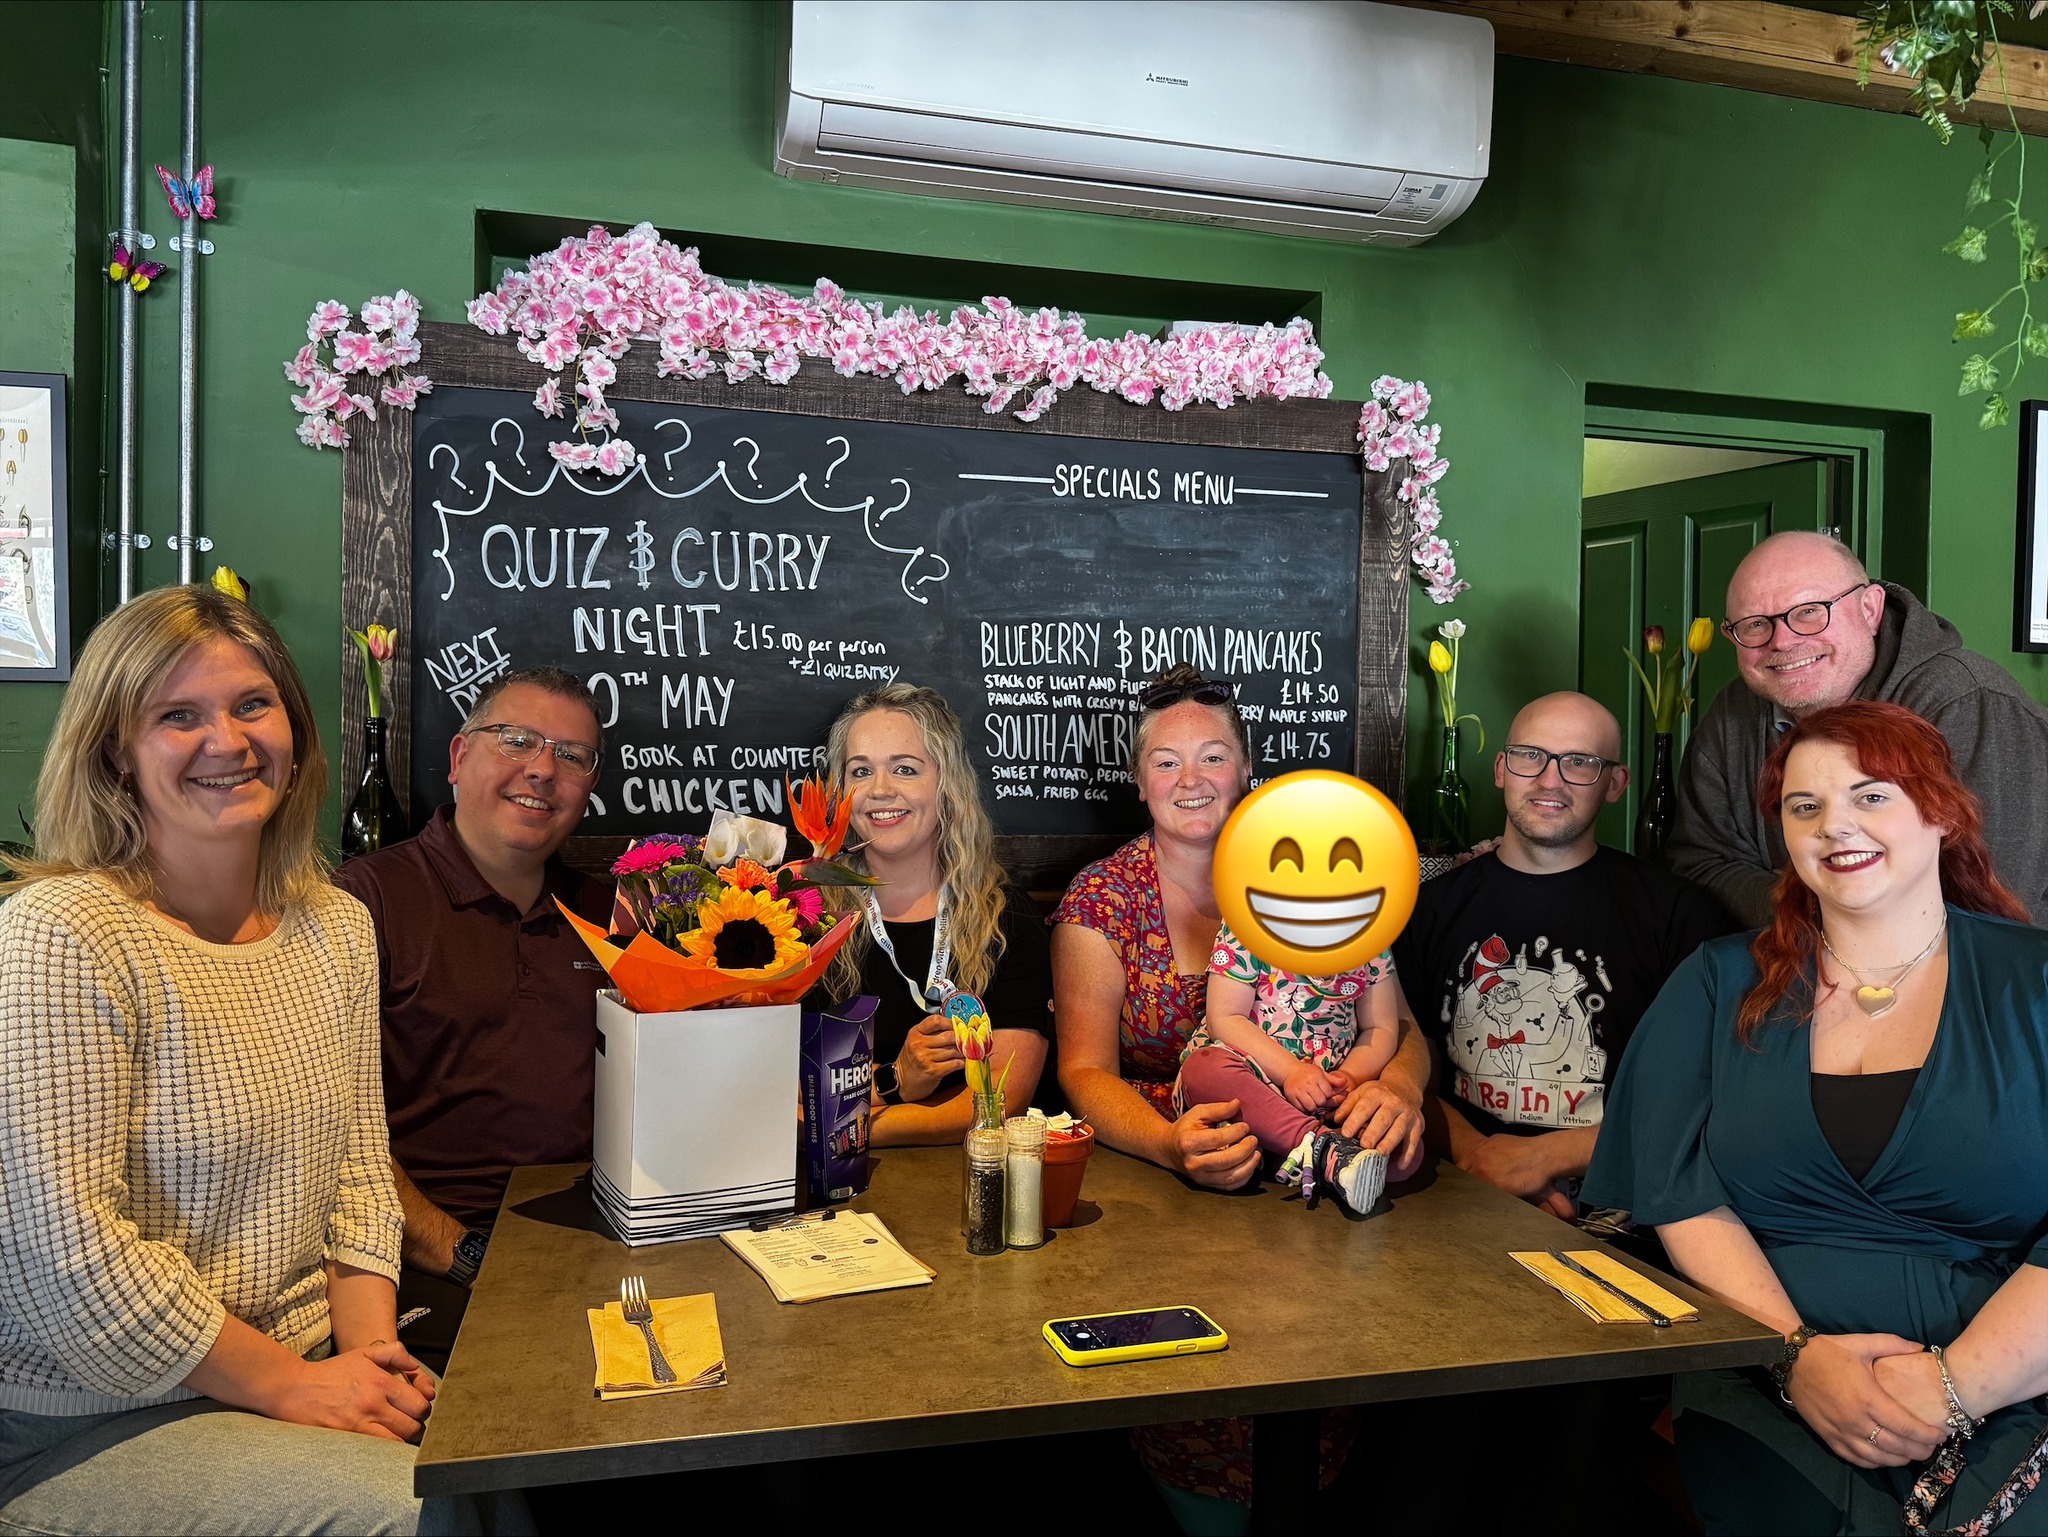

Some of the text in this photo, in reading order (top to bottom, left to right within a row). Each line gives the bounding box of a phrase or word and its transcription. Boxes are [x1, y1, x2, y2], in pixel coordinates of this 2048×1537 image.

[1052, 464, 1235, 505] SPECIALS MENU
[481, 523, 612, 593] QUIZ
[671, 526, 832, 593] CURRY
[573, 603, 721, 658] NIGHT
[733, 619, 886, 662] £15.00 per person
[424, 626, 507, 690] NEXT
[980, 620, 1101, 668] BLUEBERRY
[1141, 625, 1216, 673] BACON
[1223, 628, 1323, 676] PANCAKES
[983, 674, 1025, 690] STACK
[1026, 675, 1045, 690] OF
[1050, 675, 1087, 691] LIGHT
[1088, 676, 1117, 692] AND
[1280, 679, 1339, 706] £14.50
[661, 672, 735, 729] MAY
[987, 692, 1050, 707] PANCAKES
[1052, 694, 1083, 710] WITH
[1086, 696, 1126, 712] CRISPY
[1269, 708, 1308, 724] MAPLE
[1311, 709, 1348, 723] SYRUP
[984, 712, 1137, 767] SOUTH AMERI
[1261, 729, 1331, 763] £14.75
[620, 743, 829, 771] BOOK AT COUNTER
[991, 765, 1039, 781] SWEET
[1096, 768, 1137, 784] PEPPE
[622, 776, 783, 815] CHICKEN
[1043, 785, 1080, 801] FRIED
[1084, 788, 1110, 802] EGG
[1478, 1082, 1510, 1110] Ra
[1521, 1086, 1550, 1113] In
[1564, 1090, 1586, 1115] Y
[1549, 1083, 1558, 1091] 49
[1519, 1113, 1592, 1124] Indium Yttrium
